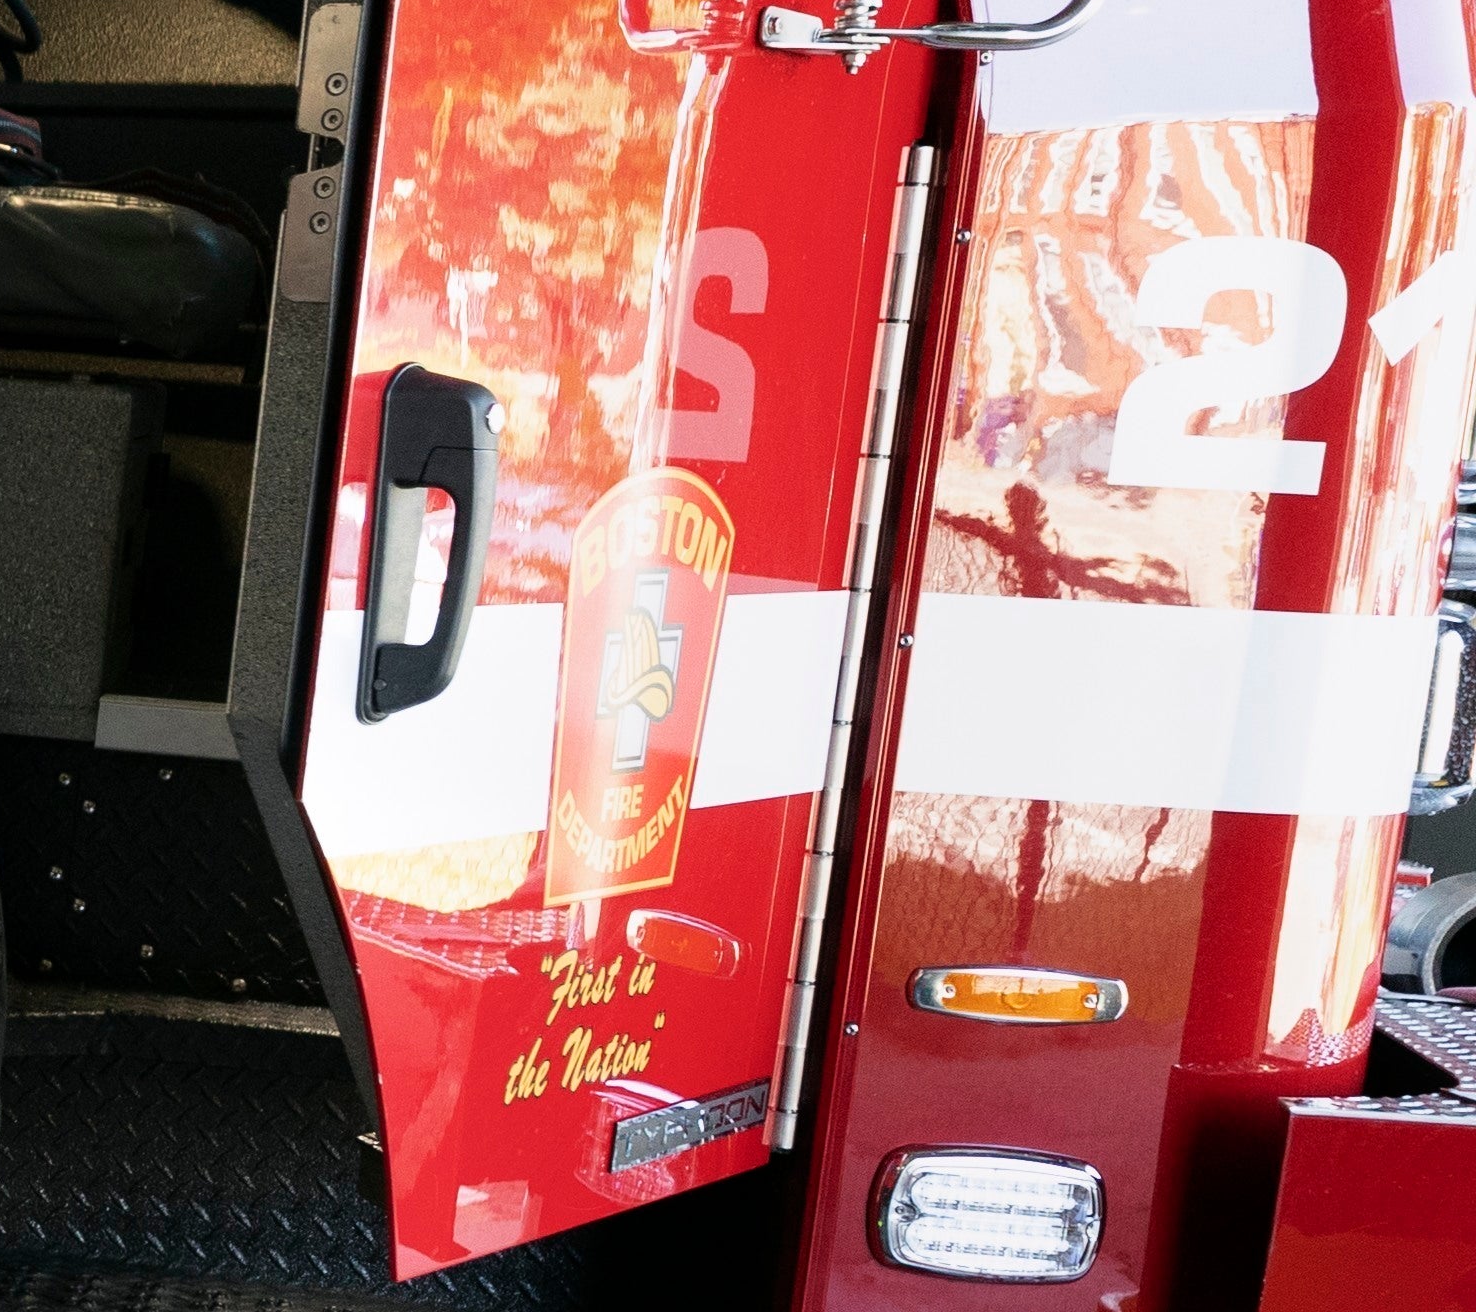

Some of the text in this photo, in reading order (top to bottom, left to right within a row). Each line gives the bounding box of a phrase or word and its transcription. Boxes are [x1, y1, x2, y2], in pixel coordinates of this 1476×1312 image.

[1107, 236, 1469, 503] 21
[577, 496, 727, 597] BOSTON
[557, 775, 686, 874] DEPARTMENT
[601, 783, 642, 823] FIRE
[540, 949, 656, 1026] "First in
[503, 1011, 666, 1105] the Nation"
